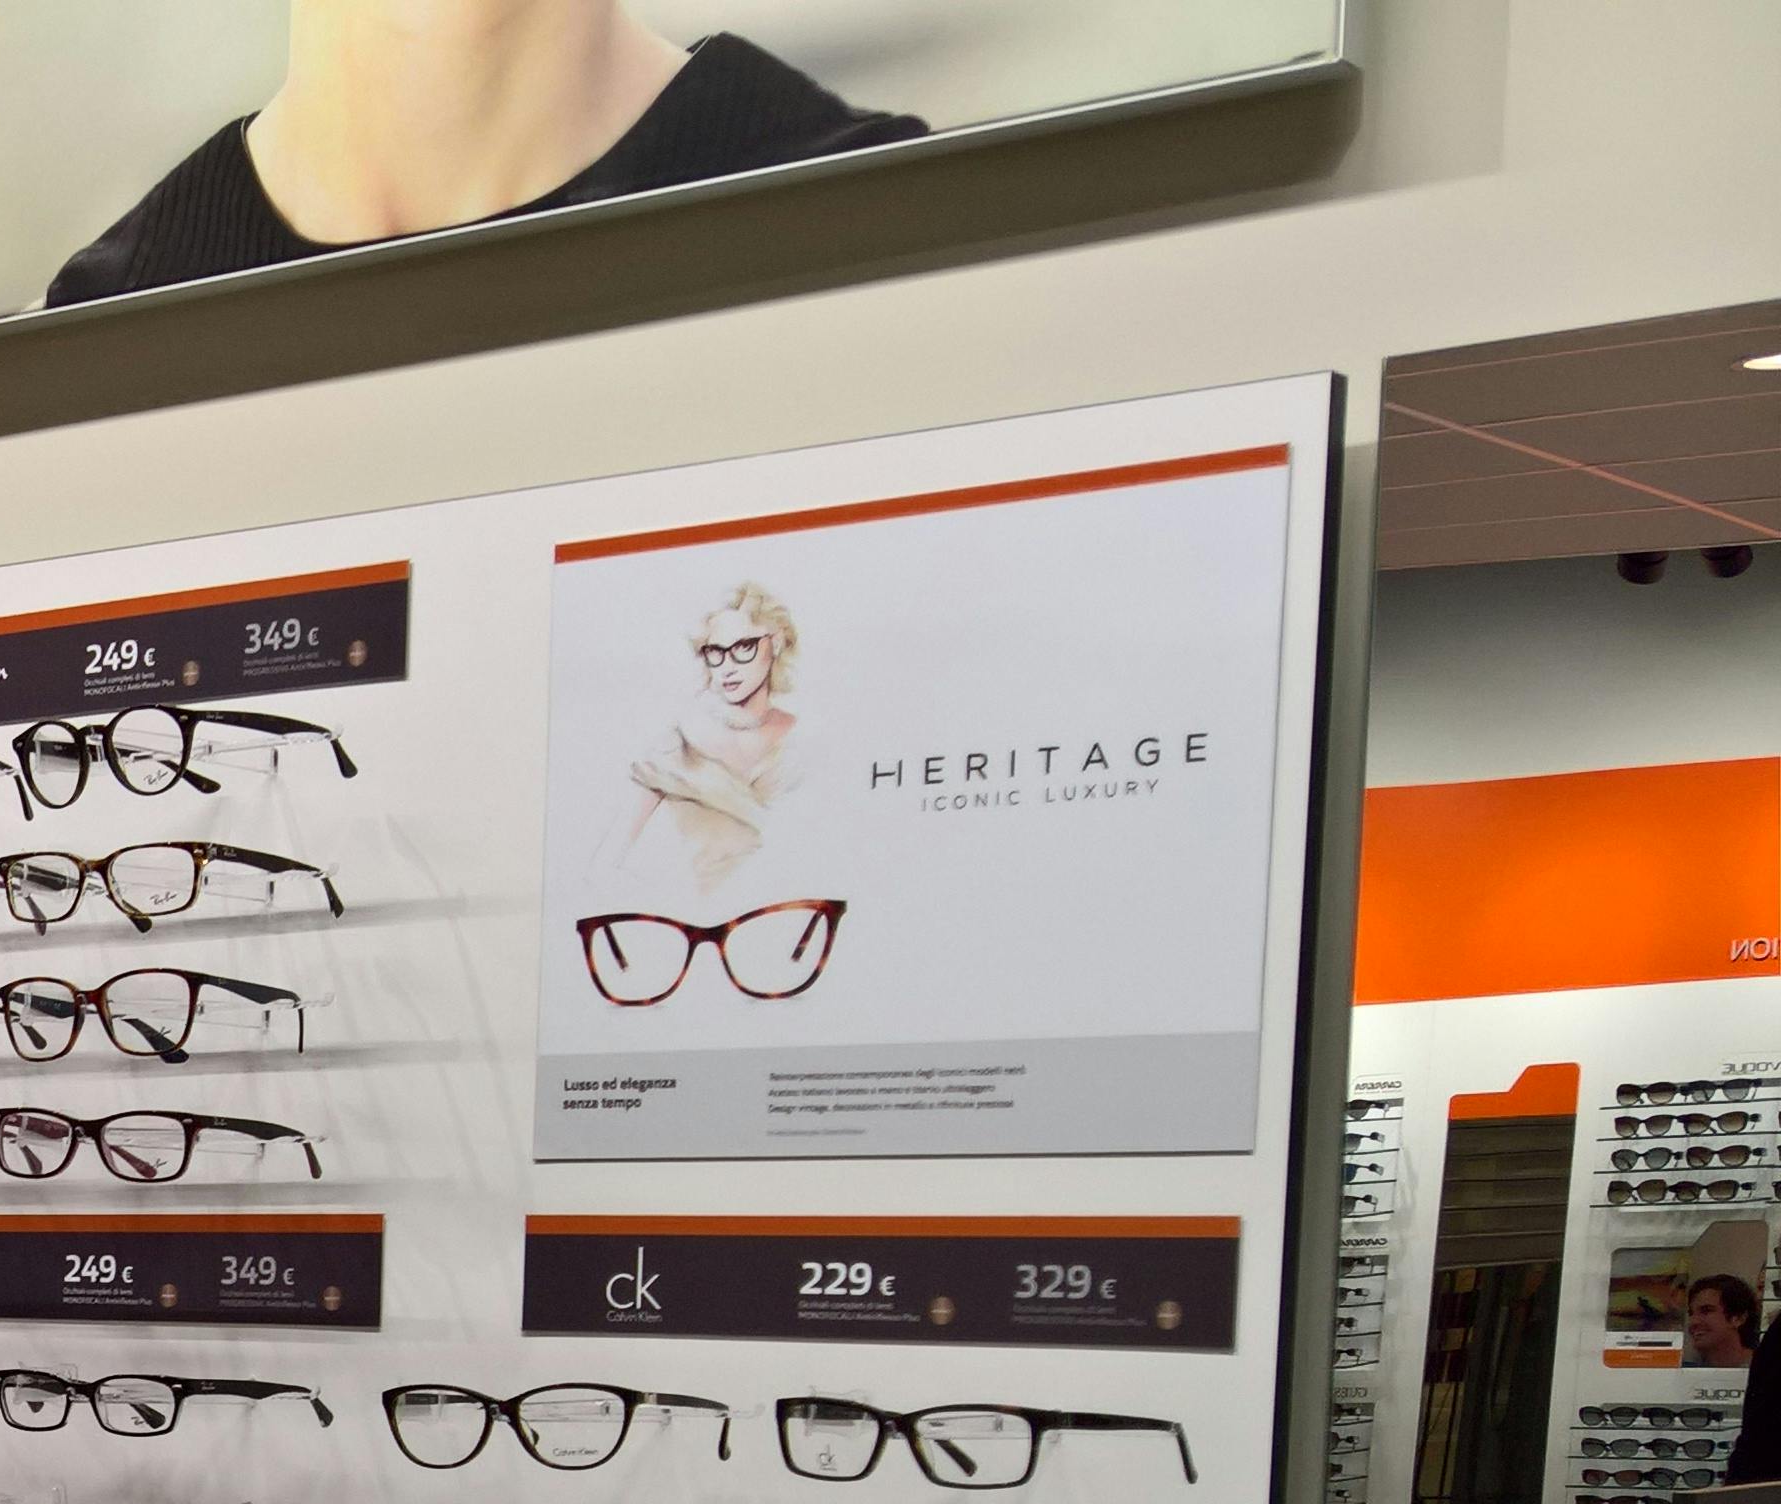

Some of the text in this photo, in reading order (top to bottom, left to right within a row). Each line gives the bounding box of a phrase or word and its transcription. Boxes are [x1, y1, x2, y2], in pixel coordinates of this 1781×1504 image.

[84, 639, 138, 675] 249
[144, 648, 156, 667] €
[244, 618, 302, 654] 349
[871, 732, 1209, 790] HERITAGE
[920, 778, 1161, 812] ICONIC LUXURY
[563, 1097, 642, 1111] senza tempo
[564, 1076, 677, 1092] Lusso ed eleganza
[606, 1246, 661, 1311] ck
[799, 1261, 873, 1297] 229
